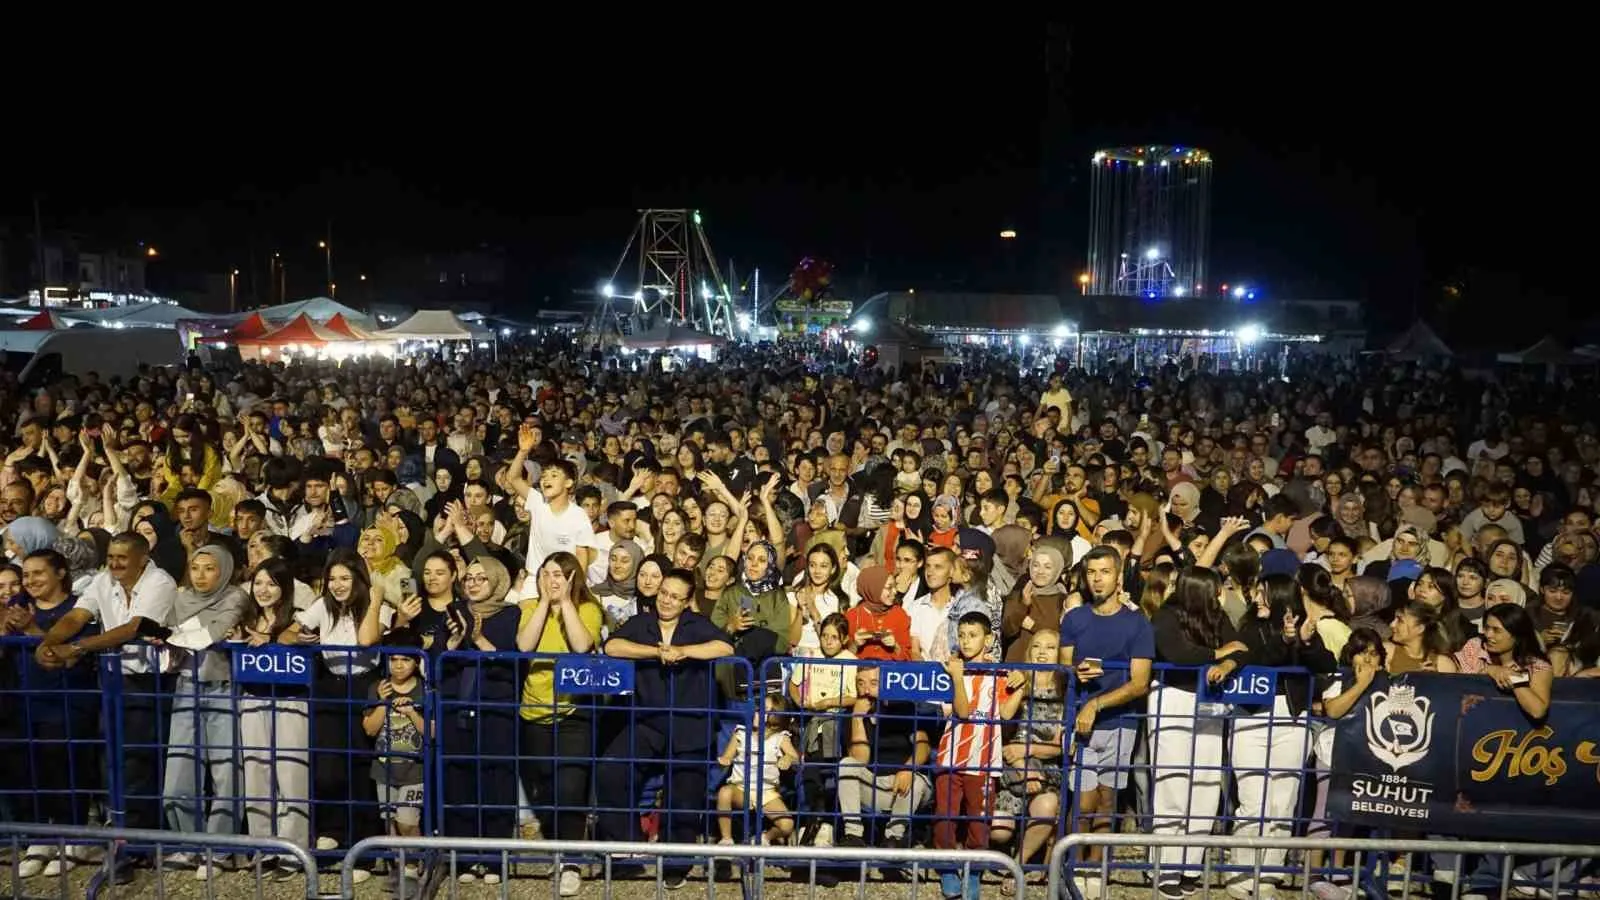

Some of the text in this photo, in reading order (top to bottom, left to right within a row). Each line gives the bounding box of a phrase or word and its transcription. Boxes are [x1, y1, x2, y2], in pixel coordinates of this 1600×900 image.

[241, 652, 306, 674] POLİS
[886, 670, 951, 692] POLİS
[1223, 673, 1269, 695] OLİS
[1471, 725, 1567, 786] Hoş
[1380, 774, 1408, 784] 1884
[1351, 779, 1433, 804] ŞUHUT
